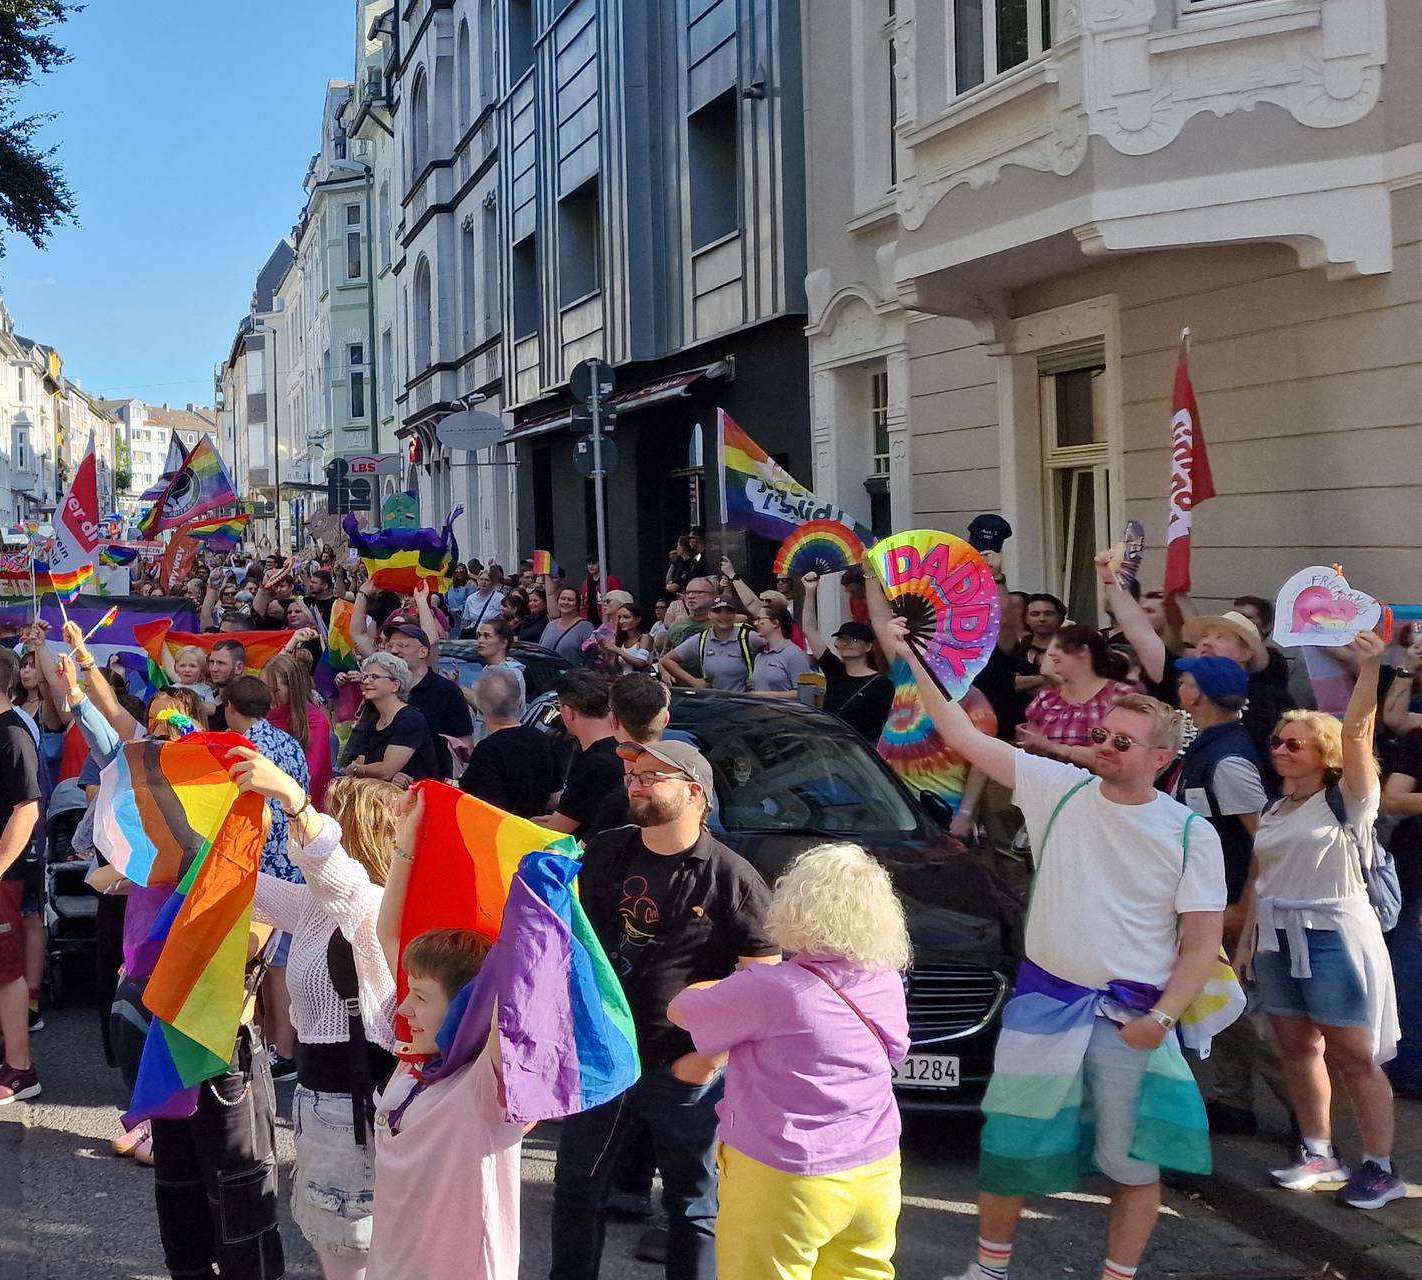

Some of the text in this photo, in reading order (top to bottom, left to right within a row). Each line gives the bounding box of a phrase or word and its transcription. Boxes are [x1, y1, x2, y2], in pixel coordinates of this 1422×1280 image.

[351, 463, 376, 473] LBS
[886, 543, 991, 679] DADDY
[904, 1058, 957, 1081] 1284
